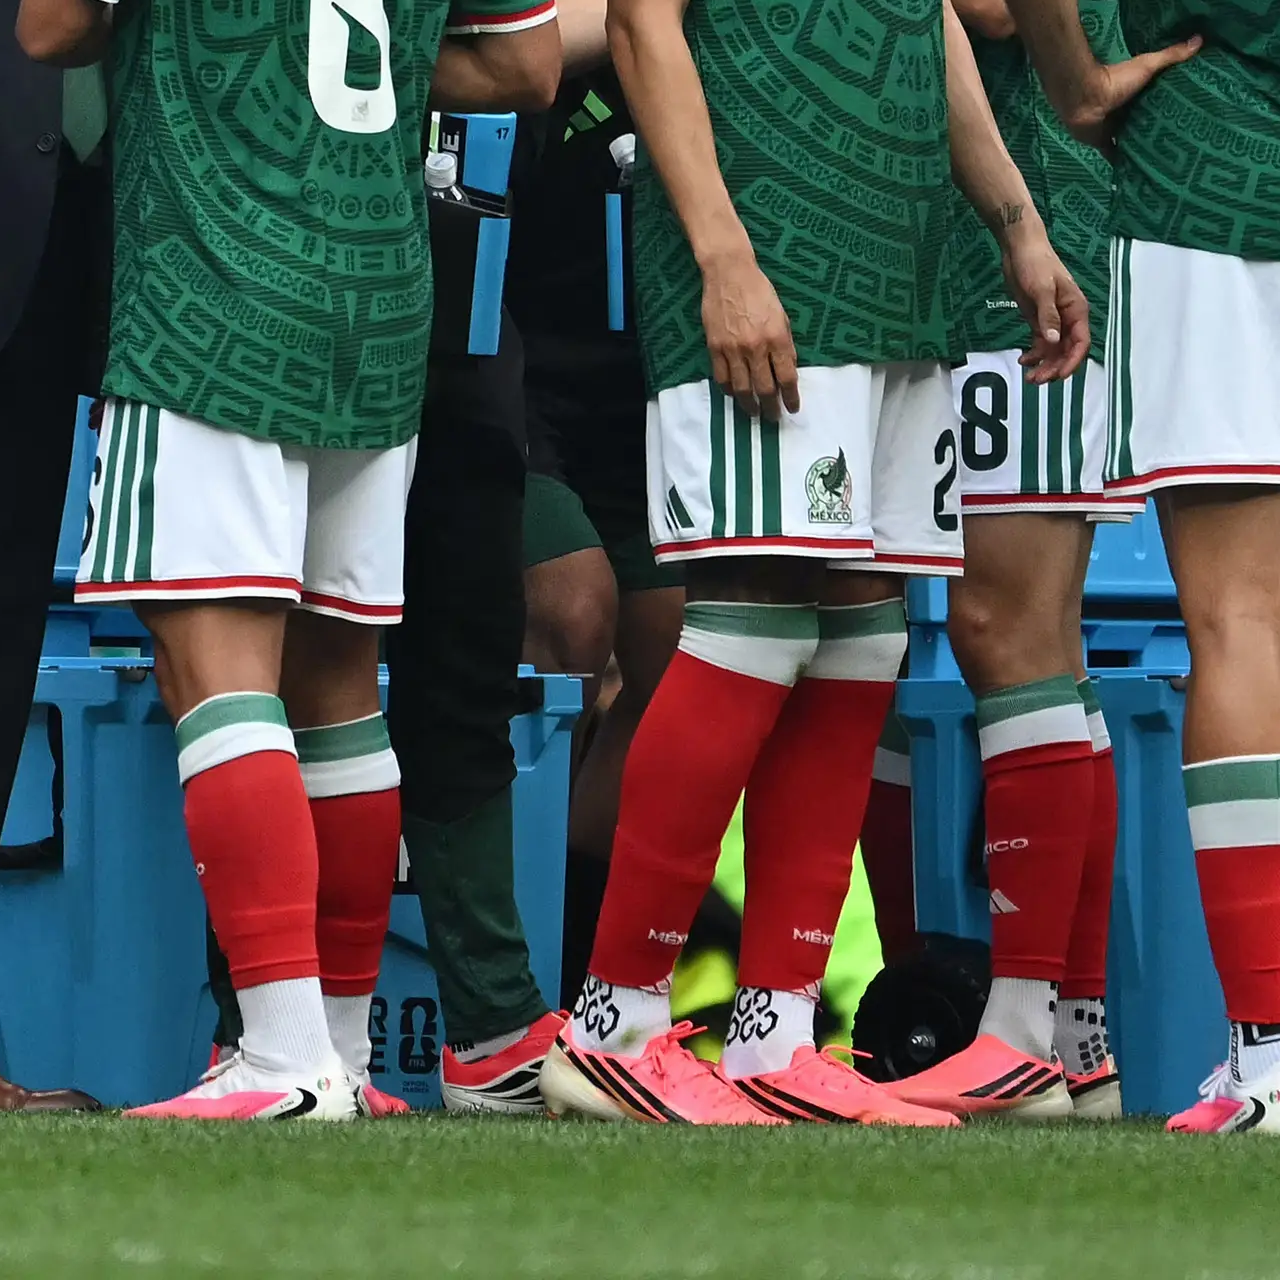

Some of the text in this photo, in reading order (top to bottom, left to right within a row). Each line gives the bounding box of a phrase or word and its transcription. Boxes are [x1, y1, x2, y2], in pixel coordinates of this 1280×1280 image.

[496, 127, 509, 140] 17
[961, 371, 1008, 471] 8
[933, 428, 958, 532] 2
[810, 509, 850, 522] MÉXICO
